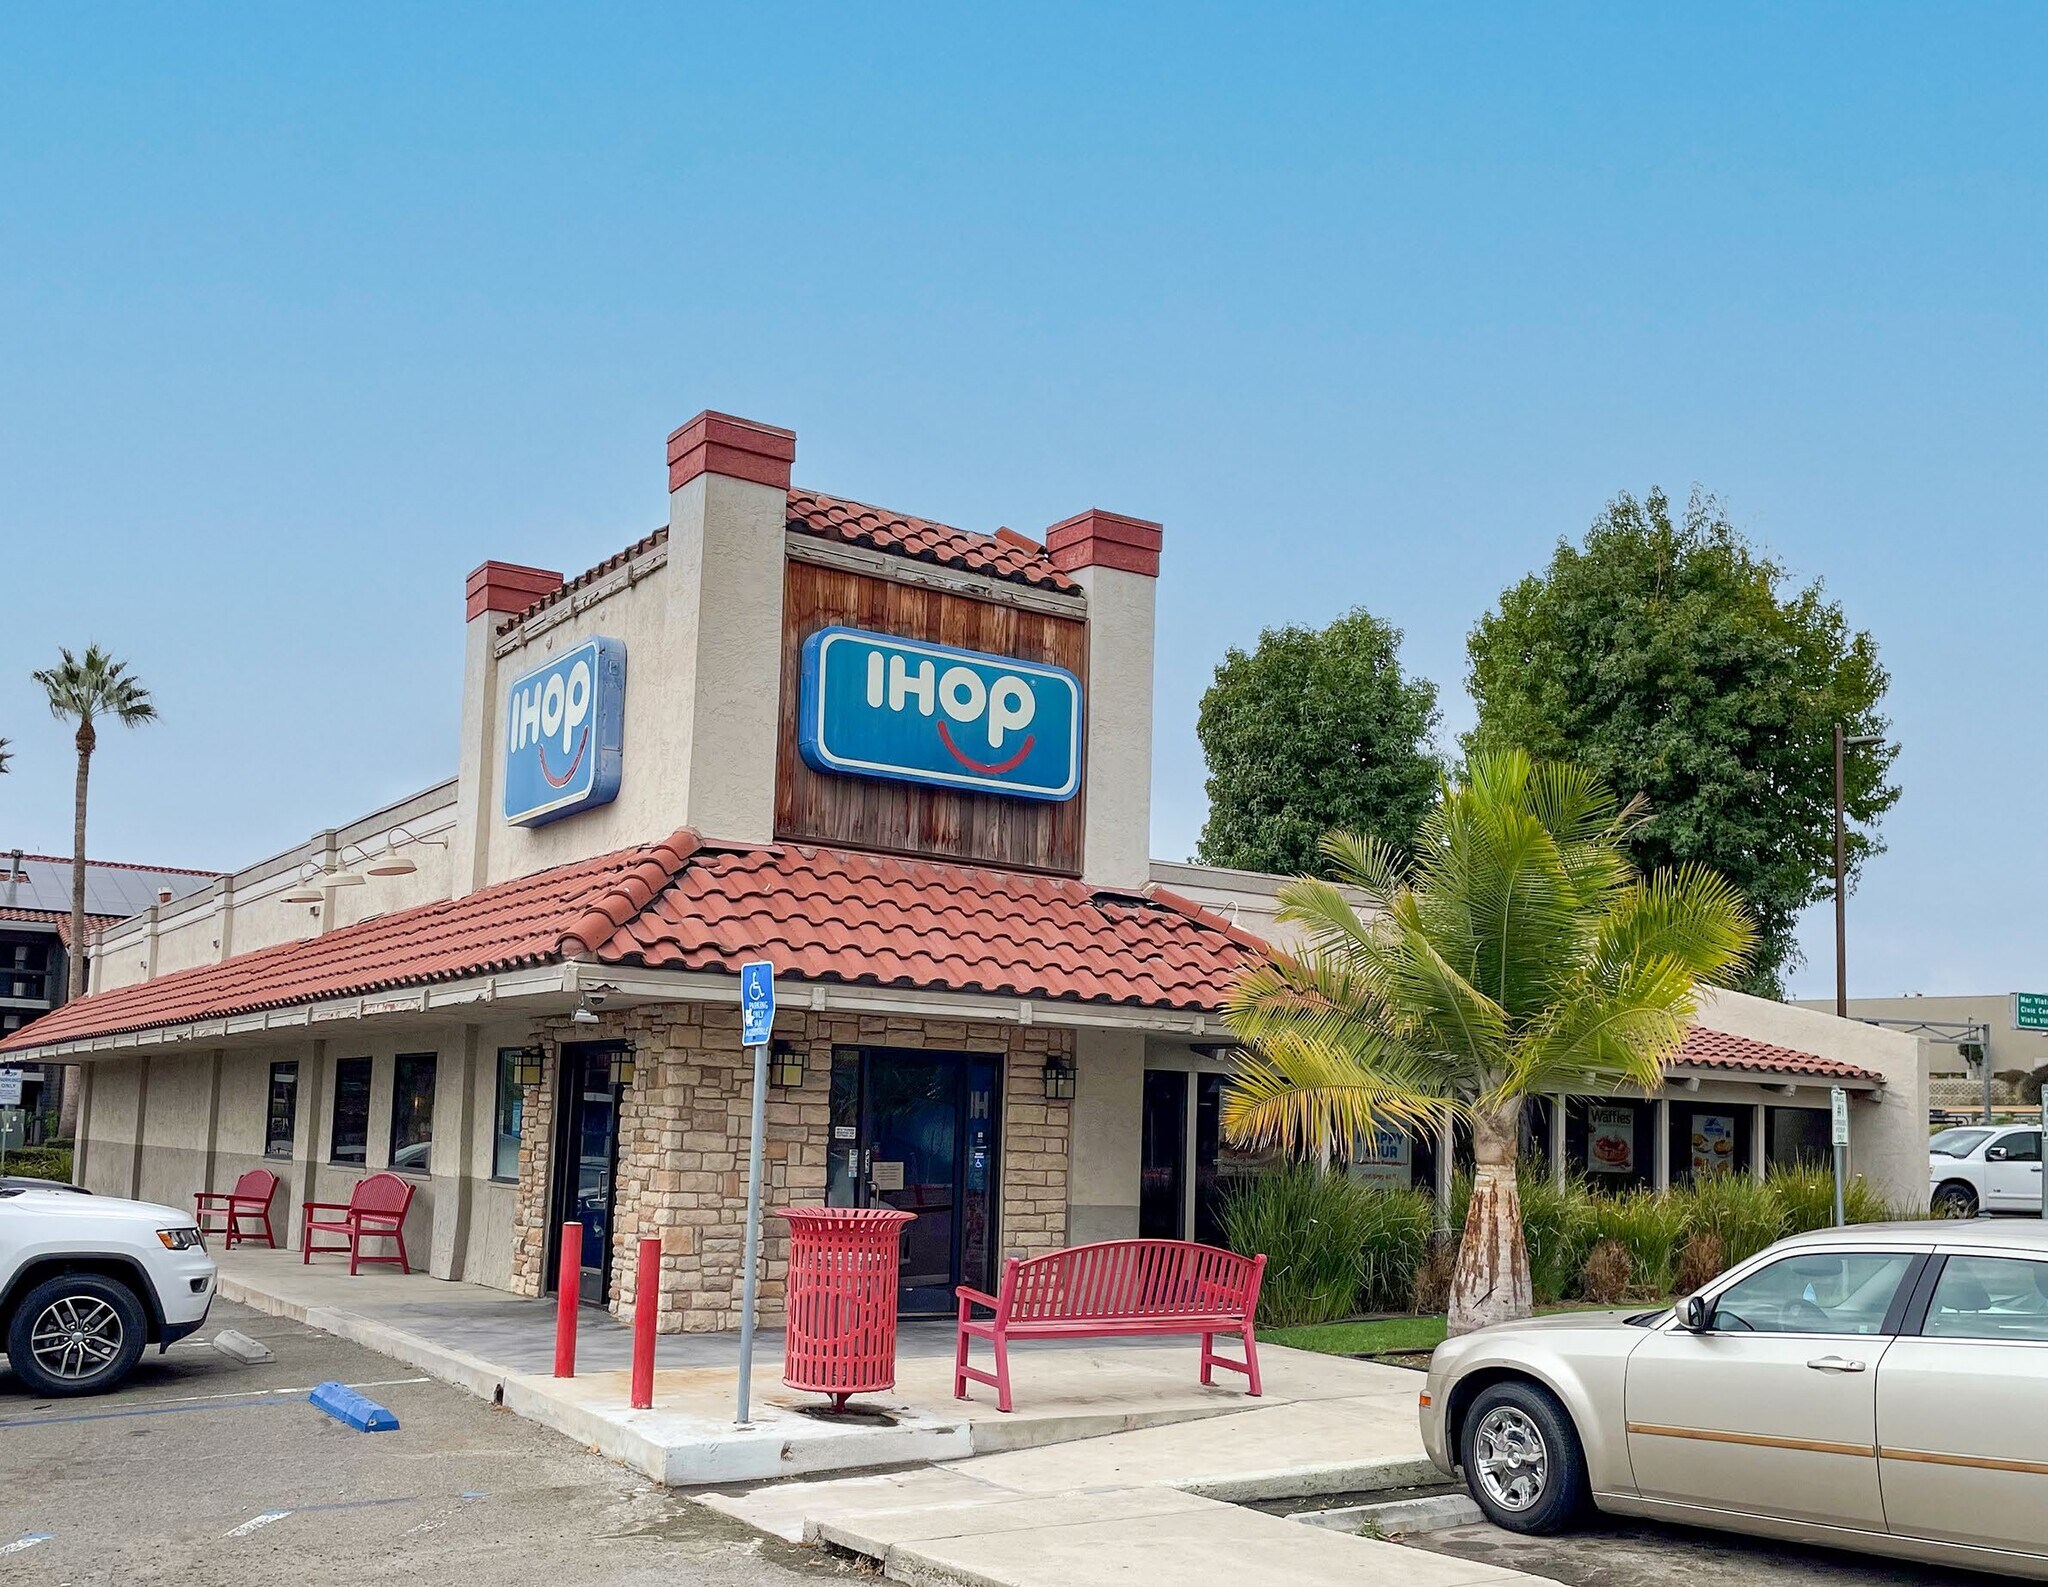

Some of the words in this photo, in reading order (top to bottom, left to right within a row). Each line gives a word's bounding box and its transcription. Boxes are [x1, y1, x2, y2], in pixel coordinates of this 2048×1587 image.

[510, 660, 591, 755] IHOP
[867, 651, 1036, 748] IHOP
[1591, 1110, 1631, 1124] Waffles
